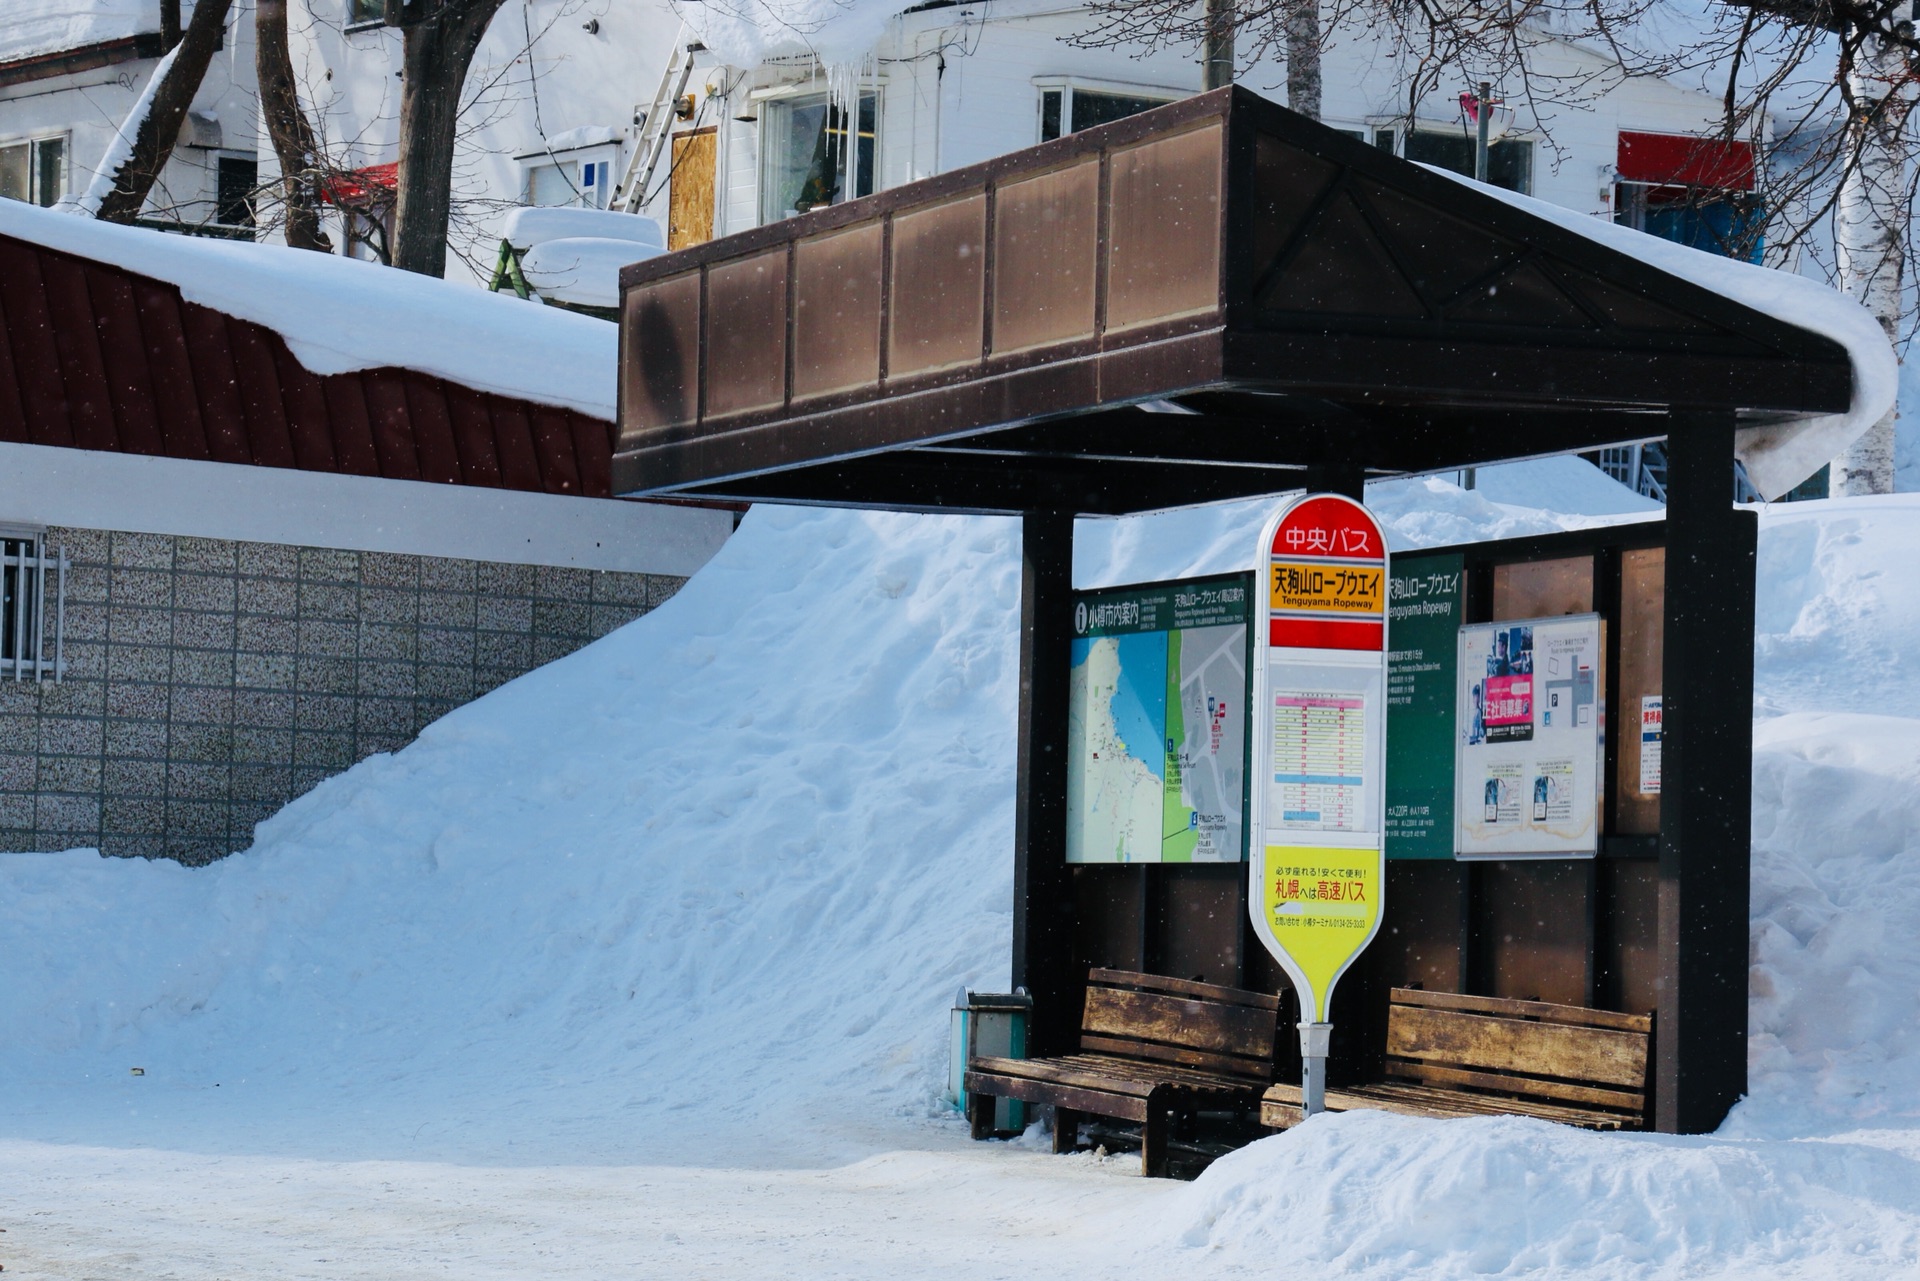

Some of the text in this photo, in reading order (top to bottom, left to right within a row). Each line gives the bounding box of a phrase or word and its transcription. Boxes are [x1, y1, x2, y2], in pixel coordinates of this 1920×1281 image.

[1286, 526, 1369, 552] 中央バス
[1275, 568, 1379, 597] 天狗山ロープウエイ
[1282, 596, 1373, 609] Tenguyama Ropeway
[1389, 601, 1452, 620] enguyama Ropeway
[1089, 601, 1139, 629] 小樽市内案内
[1276, 879, 1365, 901] 札幌へは高速バス
